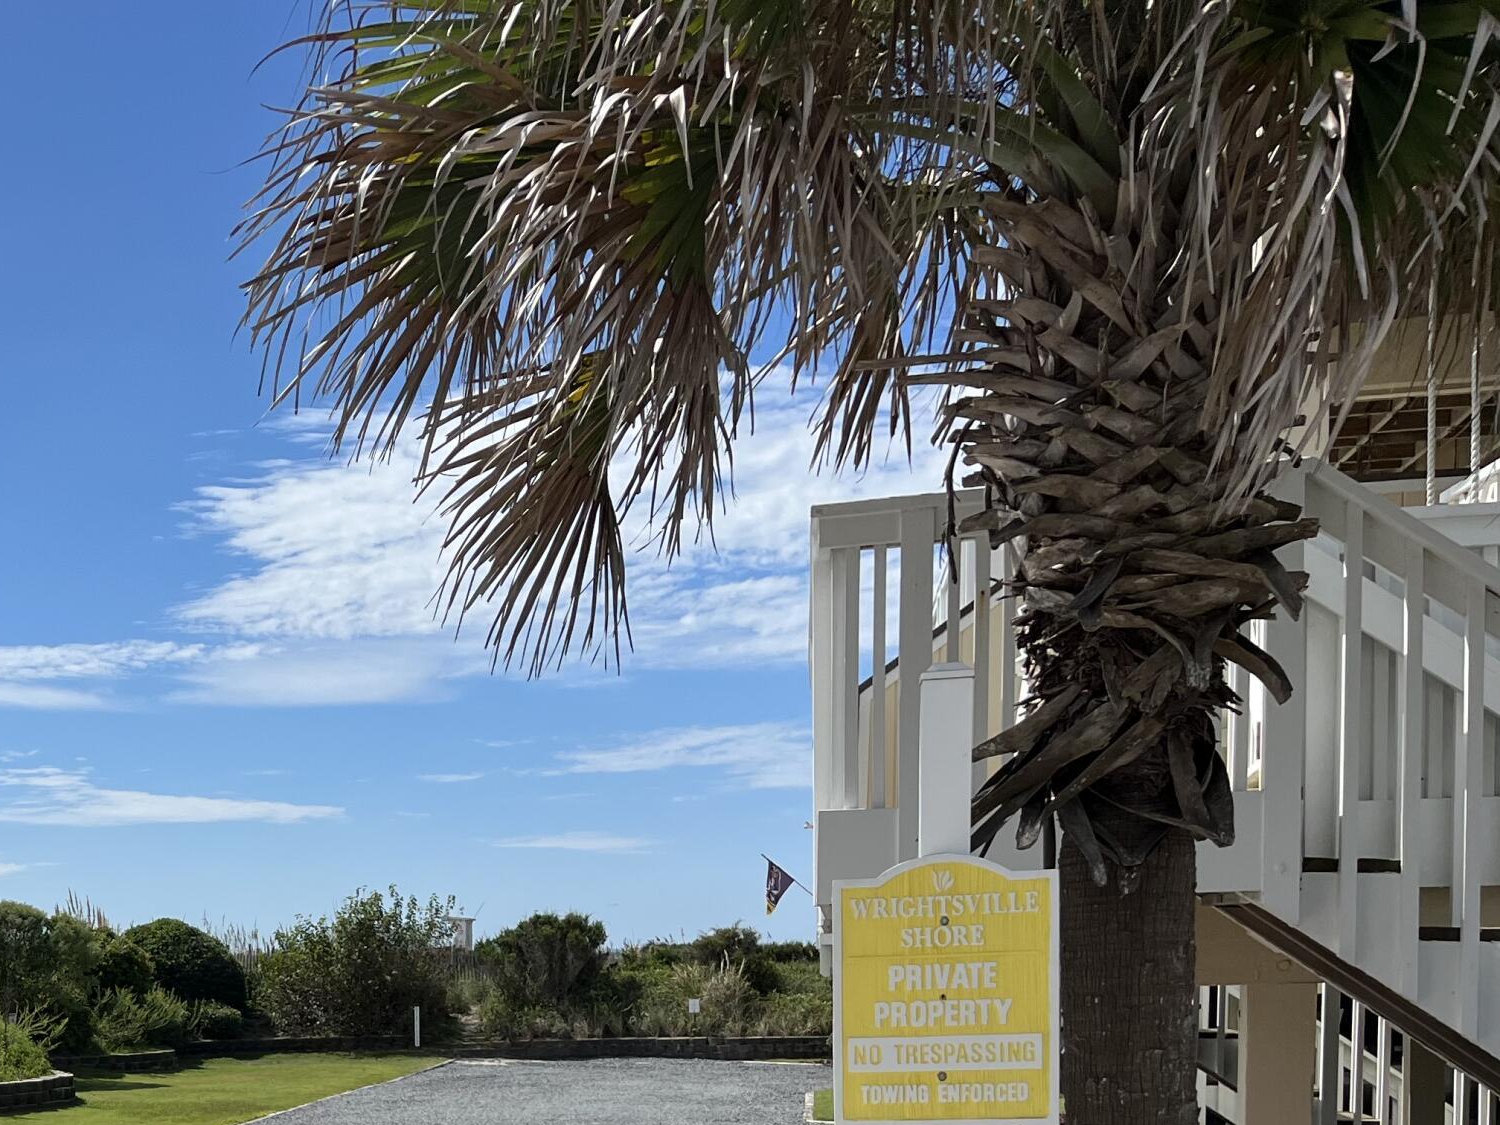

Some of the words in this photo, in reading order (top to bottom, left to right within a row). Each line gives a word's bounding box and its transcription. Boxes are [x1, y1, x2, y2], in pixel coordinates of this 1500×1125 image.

[850, 891, 1040, 919] WRIGHTSVILLE
[901, 924, 985, 948] SHORE
[888, 962, 997, 991] PRIVATE
[874, 998, 1013, 1028] PROPERTY
[854, 1044, 883, 1066] NO
[894, 1041, 1036, 1064] TRESPASSING
[861, 1083, 929, 1104] TOWING
[938, 1081, 1029, 1103] ENFORCED
